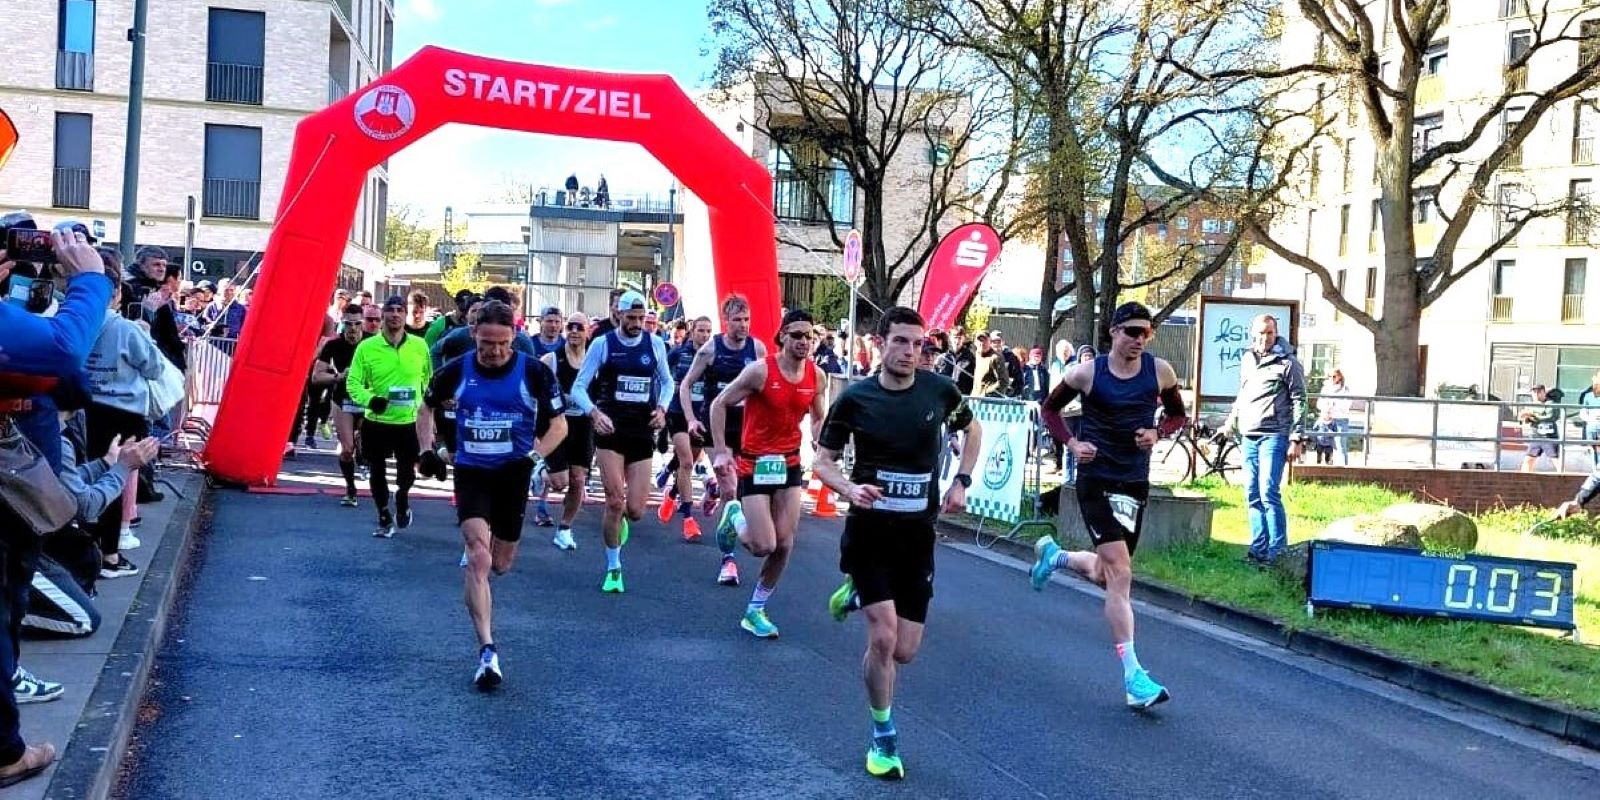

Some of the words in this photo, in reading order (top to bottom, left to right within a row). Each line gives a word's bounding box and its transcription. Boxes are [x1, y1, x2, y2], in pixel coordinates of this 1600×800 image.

[444, 68, 651, 119] START/ZIEL
[471, 428, 502, 440] 1097
[764, 461, 782, 472] 147
[887, 481, 921, 496] 1138
[1445, 564, 1562, 617] 0.03
